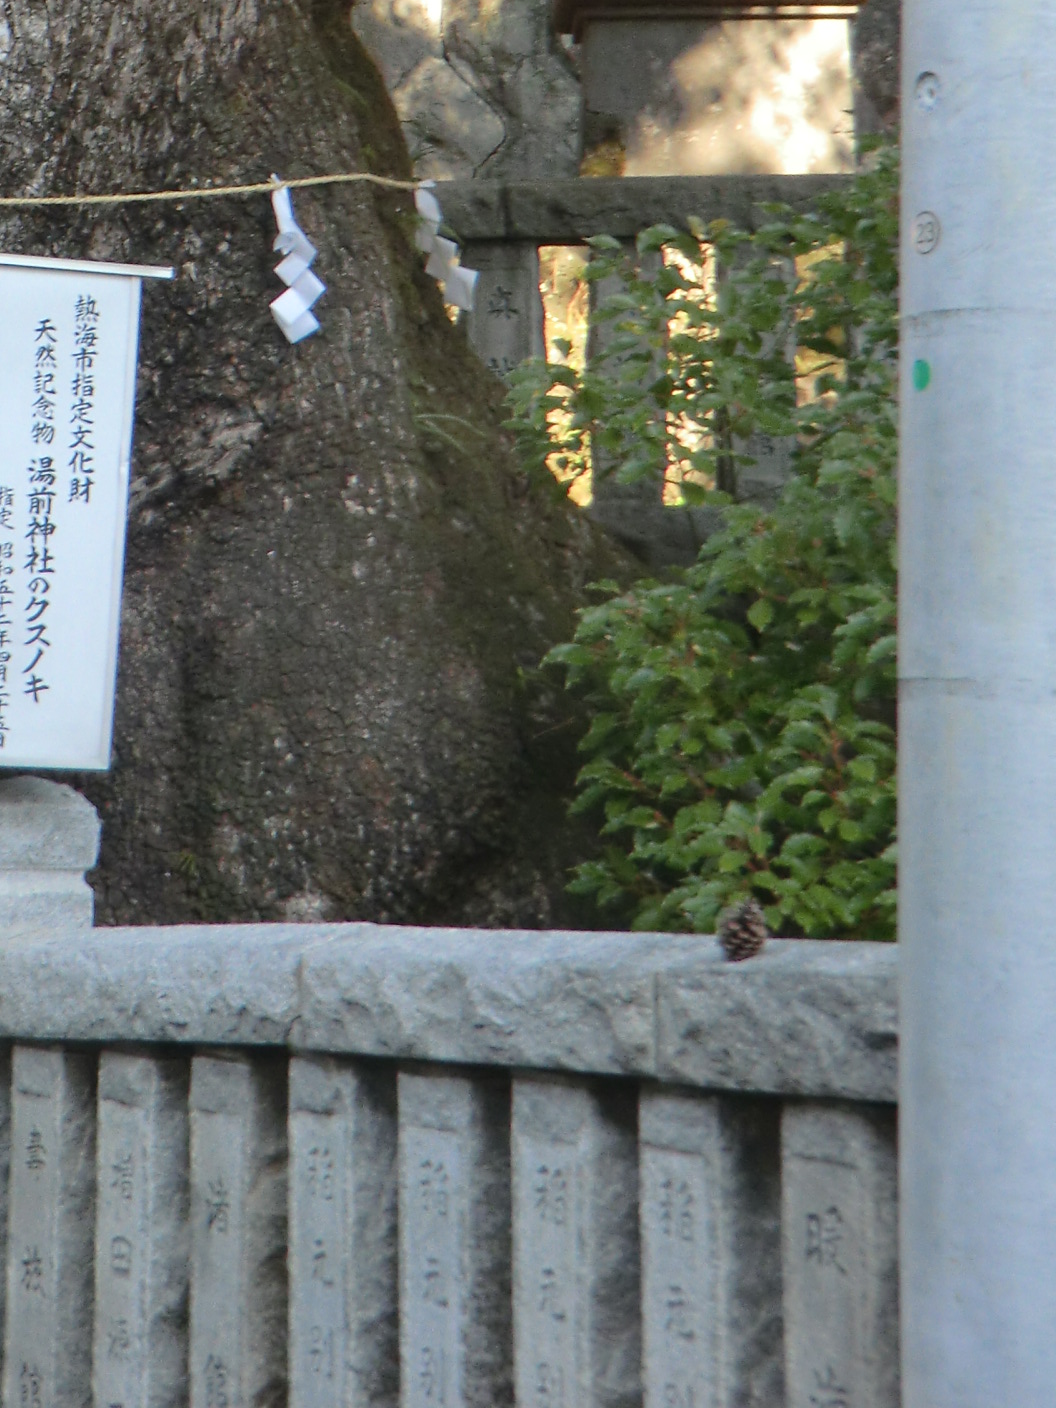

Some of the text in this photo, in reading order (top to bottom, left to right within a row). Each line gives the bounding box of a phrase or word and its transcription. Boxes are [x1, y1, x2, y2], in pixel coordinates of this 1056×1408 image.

[22, 318, 58, 704] 天然記念物 湯前神社のクスノキ
[67, 294, 100, 504] 熱海市指定文化財
